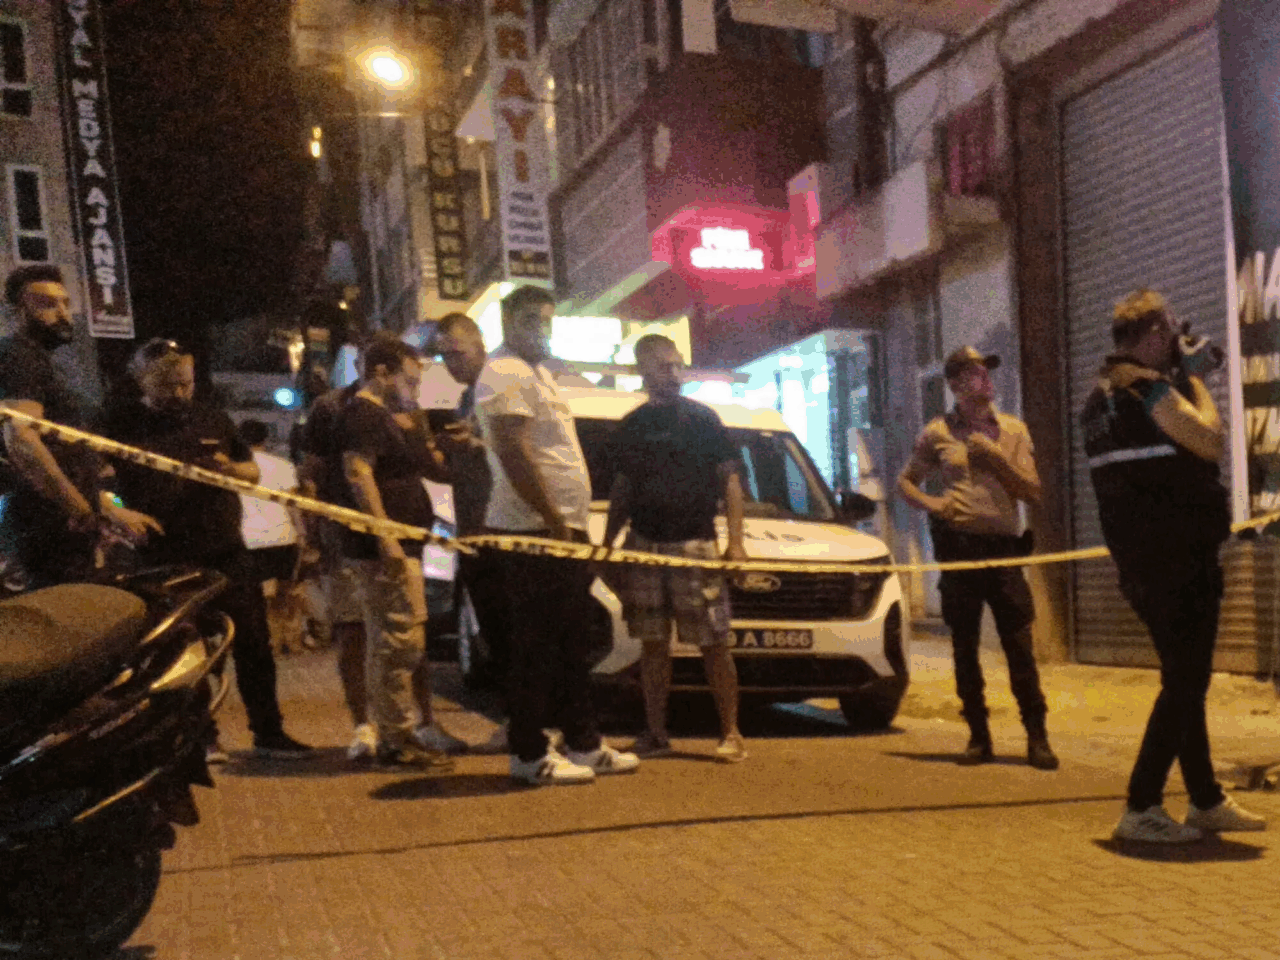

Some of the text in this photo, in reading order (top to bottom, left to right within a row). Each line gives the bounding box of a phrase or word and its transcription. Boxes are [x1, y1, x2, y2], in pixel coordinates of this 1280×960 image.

[71, 78, 107, 178] MEDYA
[86, 186, 118, 305] AJANSI
[742, 631, 759, 647] A
